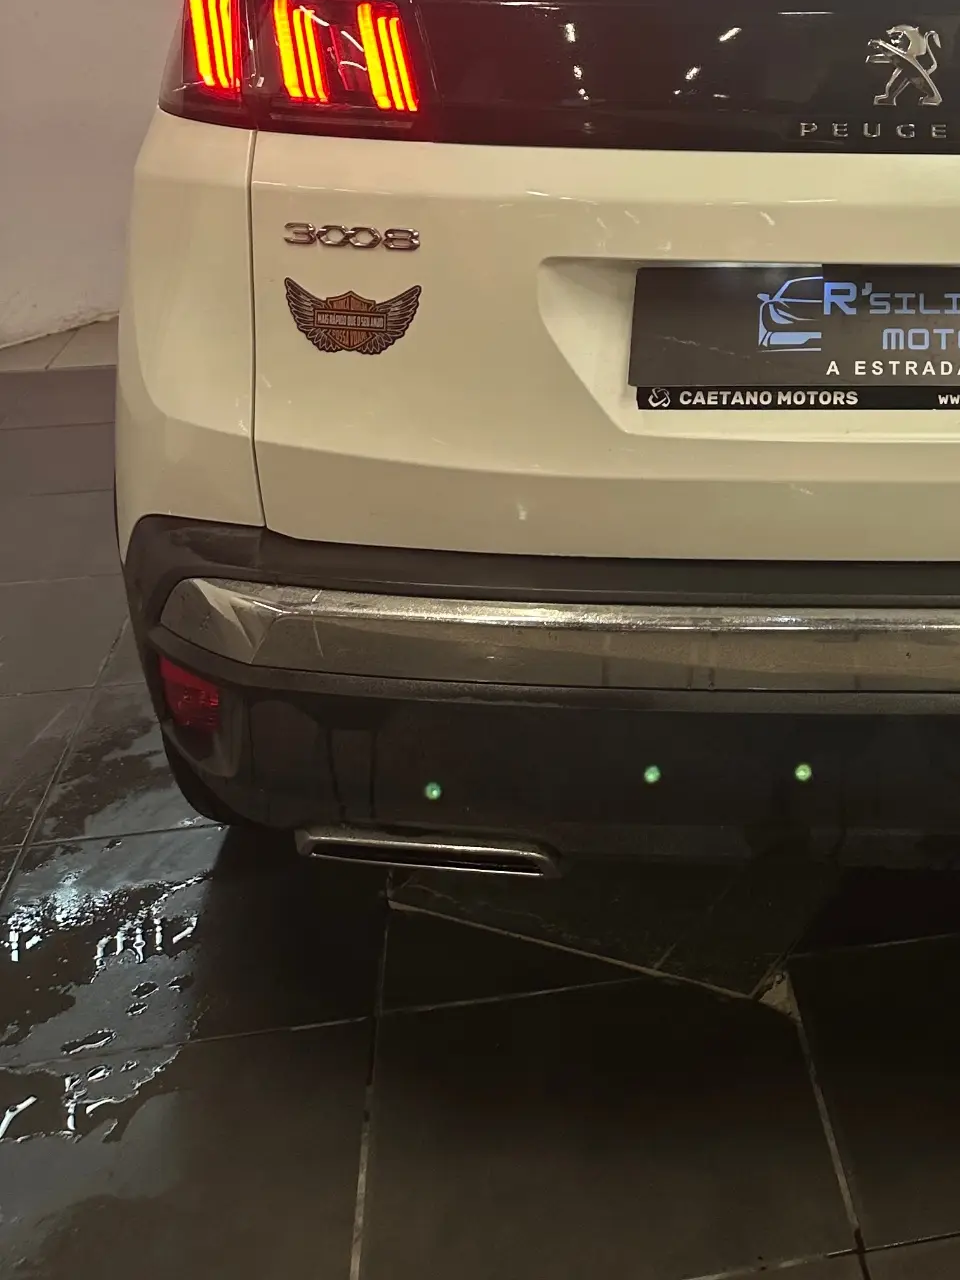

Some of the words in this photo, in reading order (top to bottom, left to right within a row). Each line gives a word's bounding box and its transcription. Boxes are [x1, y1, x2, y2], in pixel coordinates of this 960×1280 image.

[284, 222, 421, 250] 3008
[826, 361, 840, 376] A
[679, 390, 772, 406] CAETANO
[777, 390, 859, 406] MOTORS
